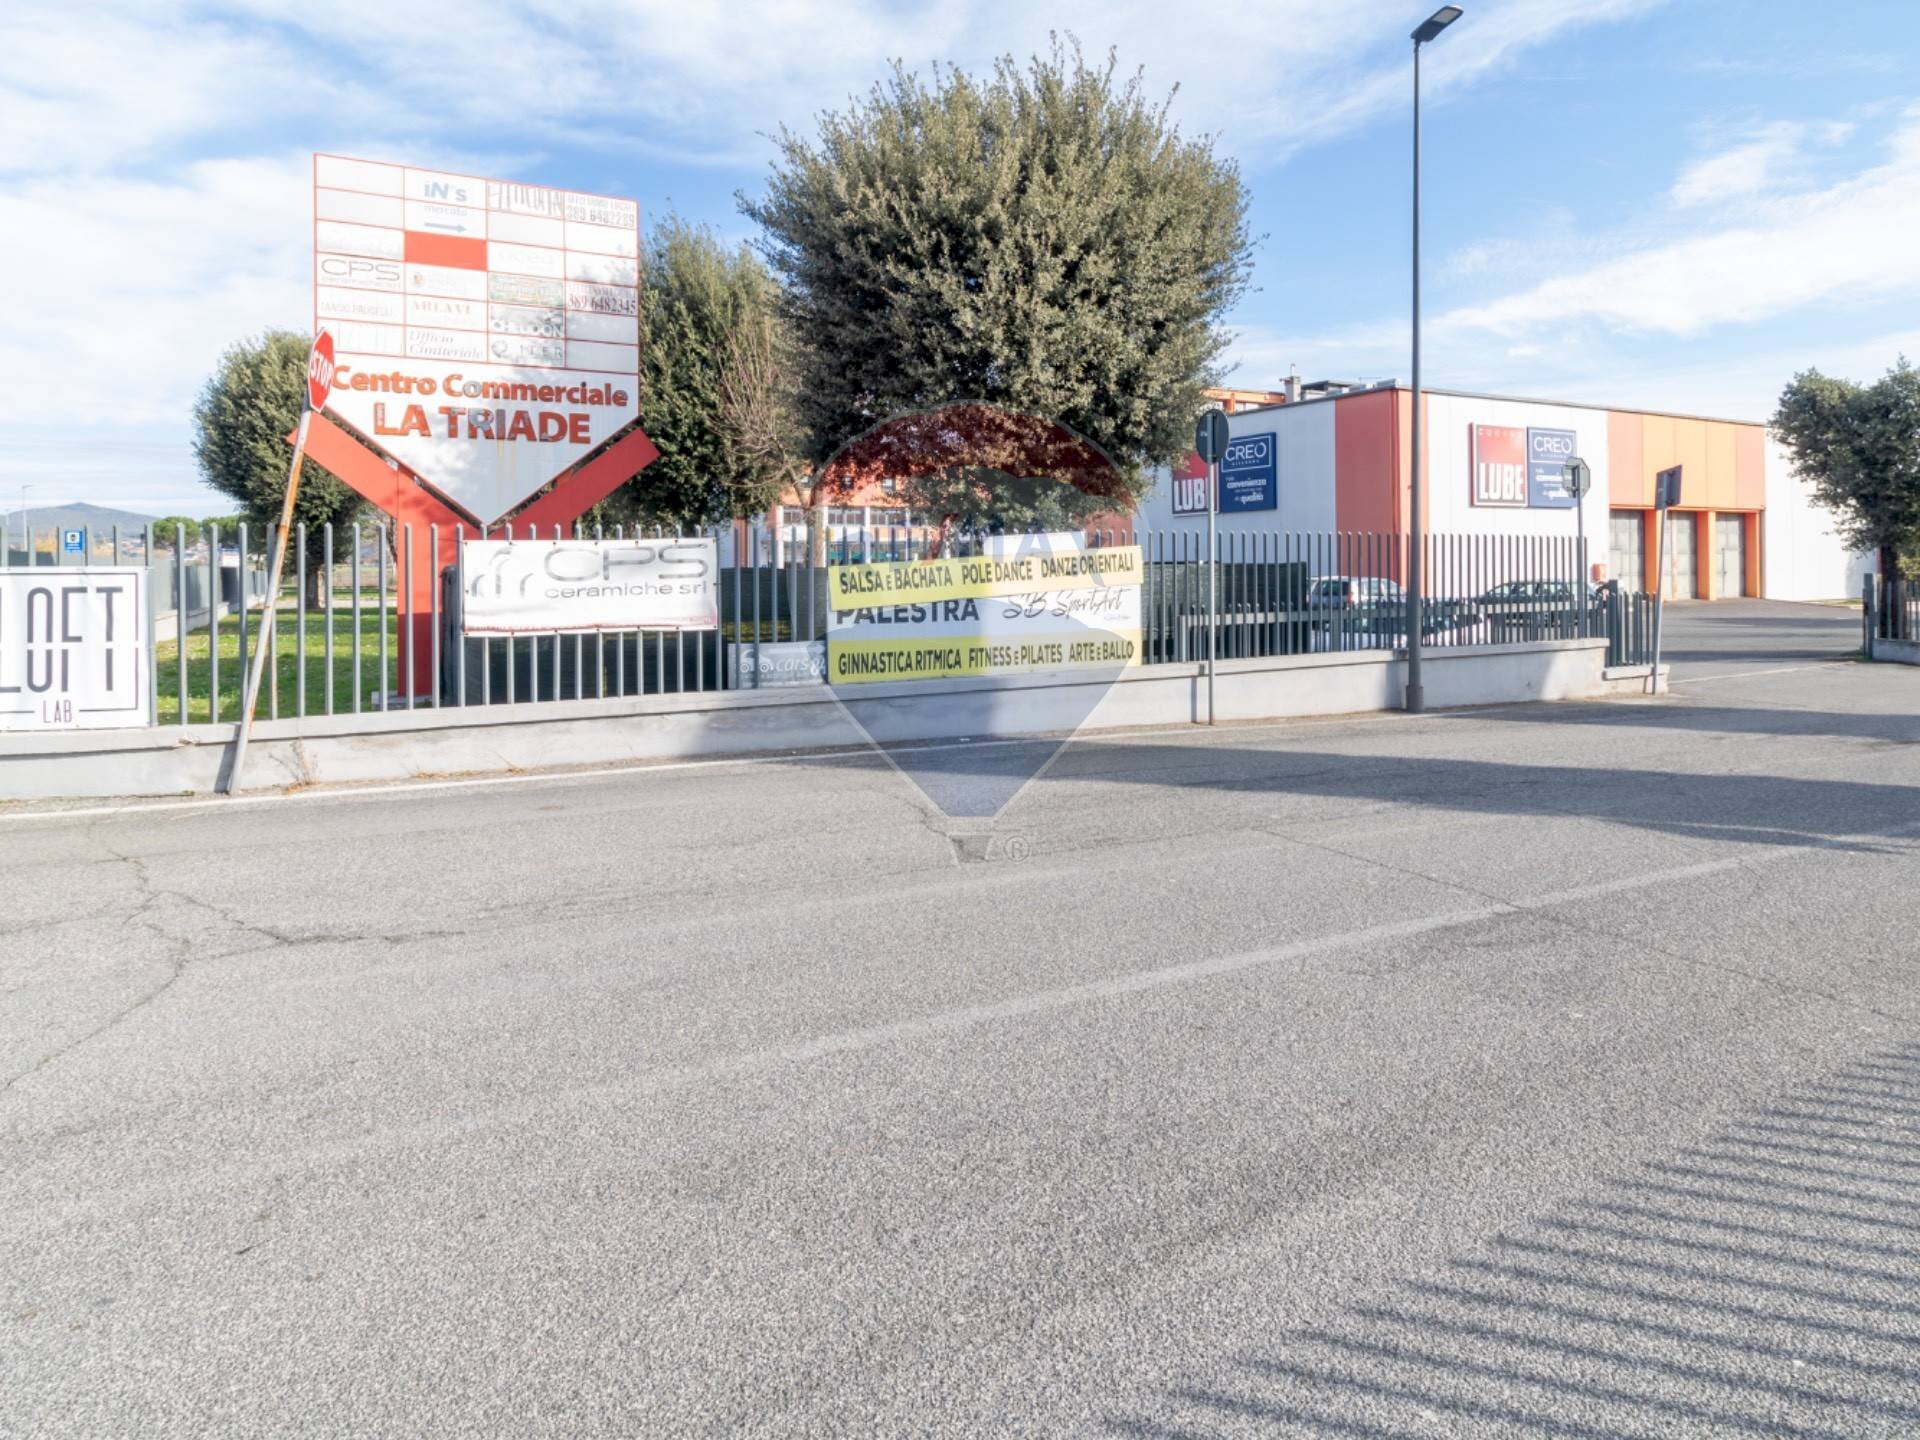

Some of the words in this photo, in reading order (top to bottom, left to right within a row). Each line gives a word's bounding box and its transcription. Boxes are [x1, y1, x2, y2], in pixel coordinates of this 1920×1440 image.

[321, 259, 400, 282] CPS
[310, 349, 333, 388] STOP
[332, 366, 436, 396] Centro
[443, 374, 629, 407] Commerciale
[373, 402, 432, 437] LA
[438, 406, 592, 444] TRIADE
[1226, 442, 1267, 461] CREO
[1534, 437, 1572, 453] CREO
[1174, 478, 1209, 511] LUB
[1480, 463, 1524, 499] LUBE
[543, 543, 709, 582] CPS
[840, 569, 884, 594] SALSA
[894, 566, 953, 588] BACHATA
[961, 561, 992, 584] POLE
[995, 559, 1033, 581] DANCE
[1041, 556, 1078, 578] DANZE
[1079, 552, 1135, 575] ORIENTALI
[544, 581, 673, 599] ceramiche
[678, 580, 707, 596] srl
[837, 598, 979, 625] PALESTRA
[838, 651, 912, 675] GINNASTICA
[915, 648, 962, 672] RITMICA
[968, 647, 1012, 668] FITNESS
[1021, 644, 1063, 666] PILATES
[1069, 643, 1095, 663] ARTE
[1102, 640, 1135, 661] BALLO
[42, 700, 73, 724] LAB
